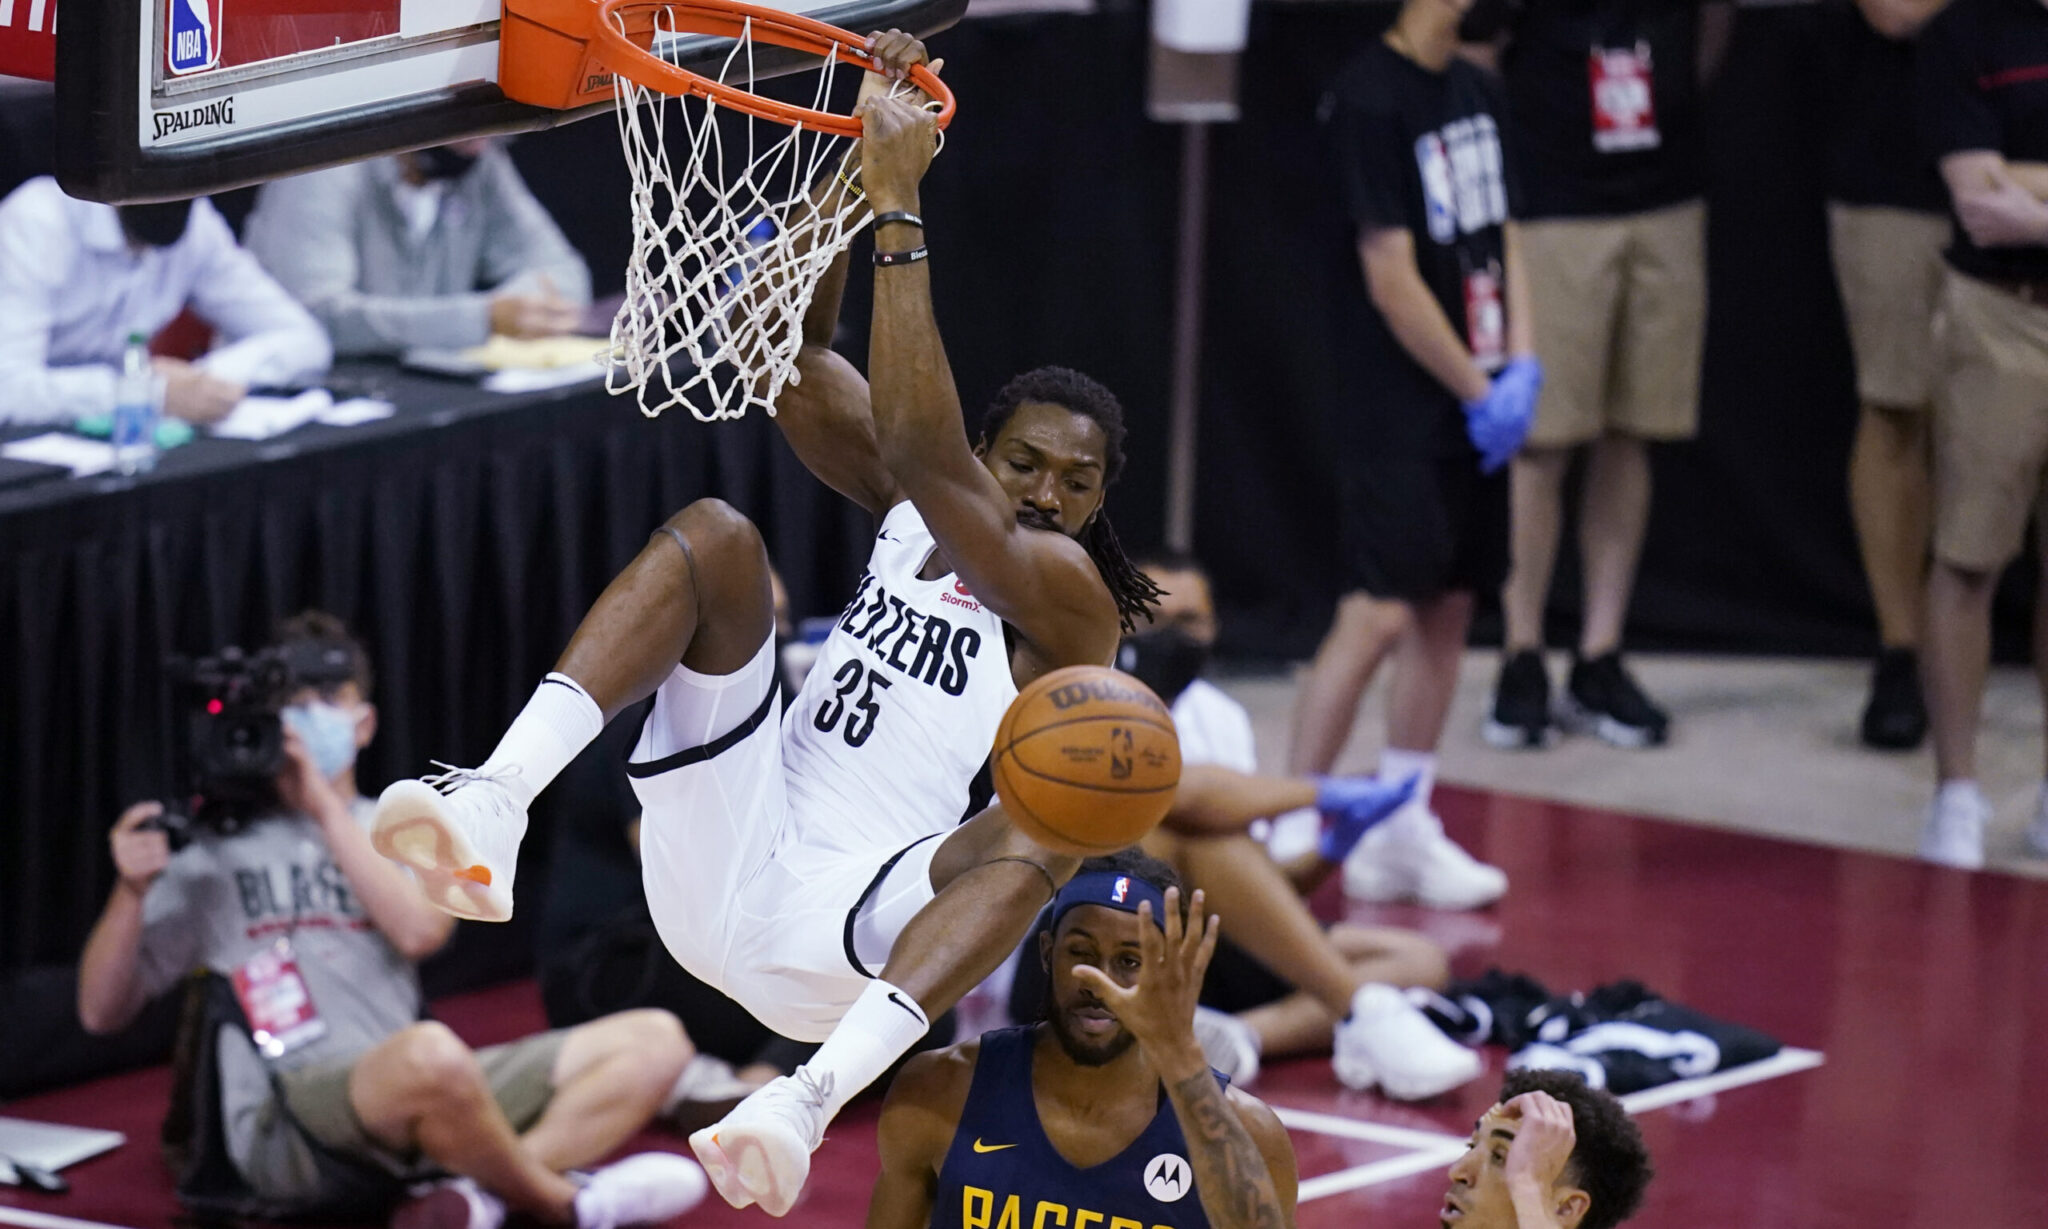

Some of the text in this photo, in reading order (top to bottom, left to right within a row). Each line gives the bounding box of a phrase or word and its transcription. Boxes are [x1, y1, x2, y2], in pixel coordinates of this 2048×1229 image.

[176, 28, 202, 62] NBA
[152, 96, 234, 140] SPALDING
[838, 568, 981, 697] LAZERS
[814, 658, 893, 748] 35
[962, 1185, 1175, 1229] PAC
